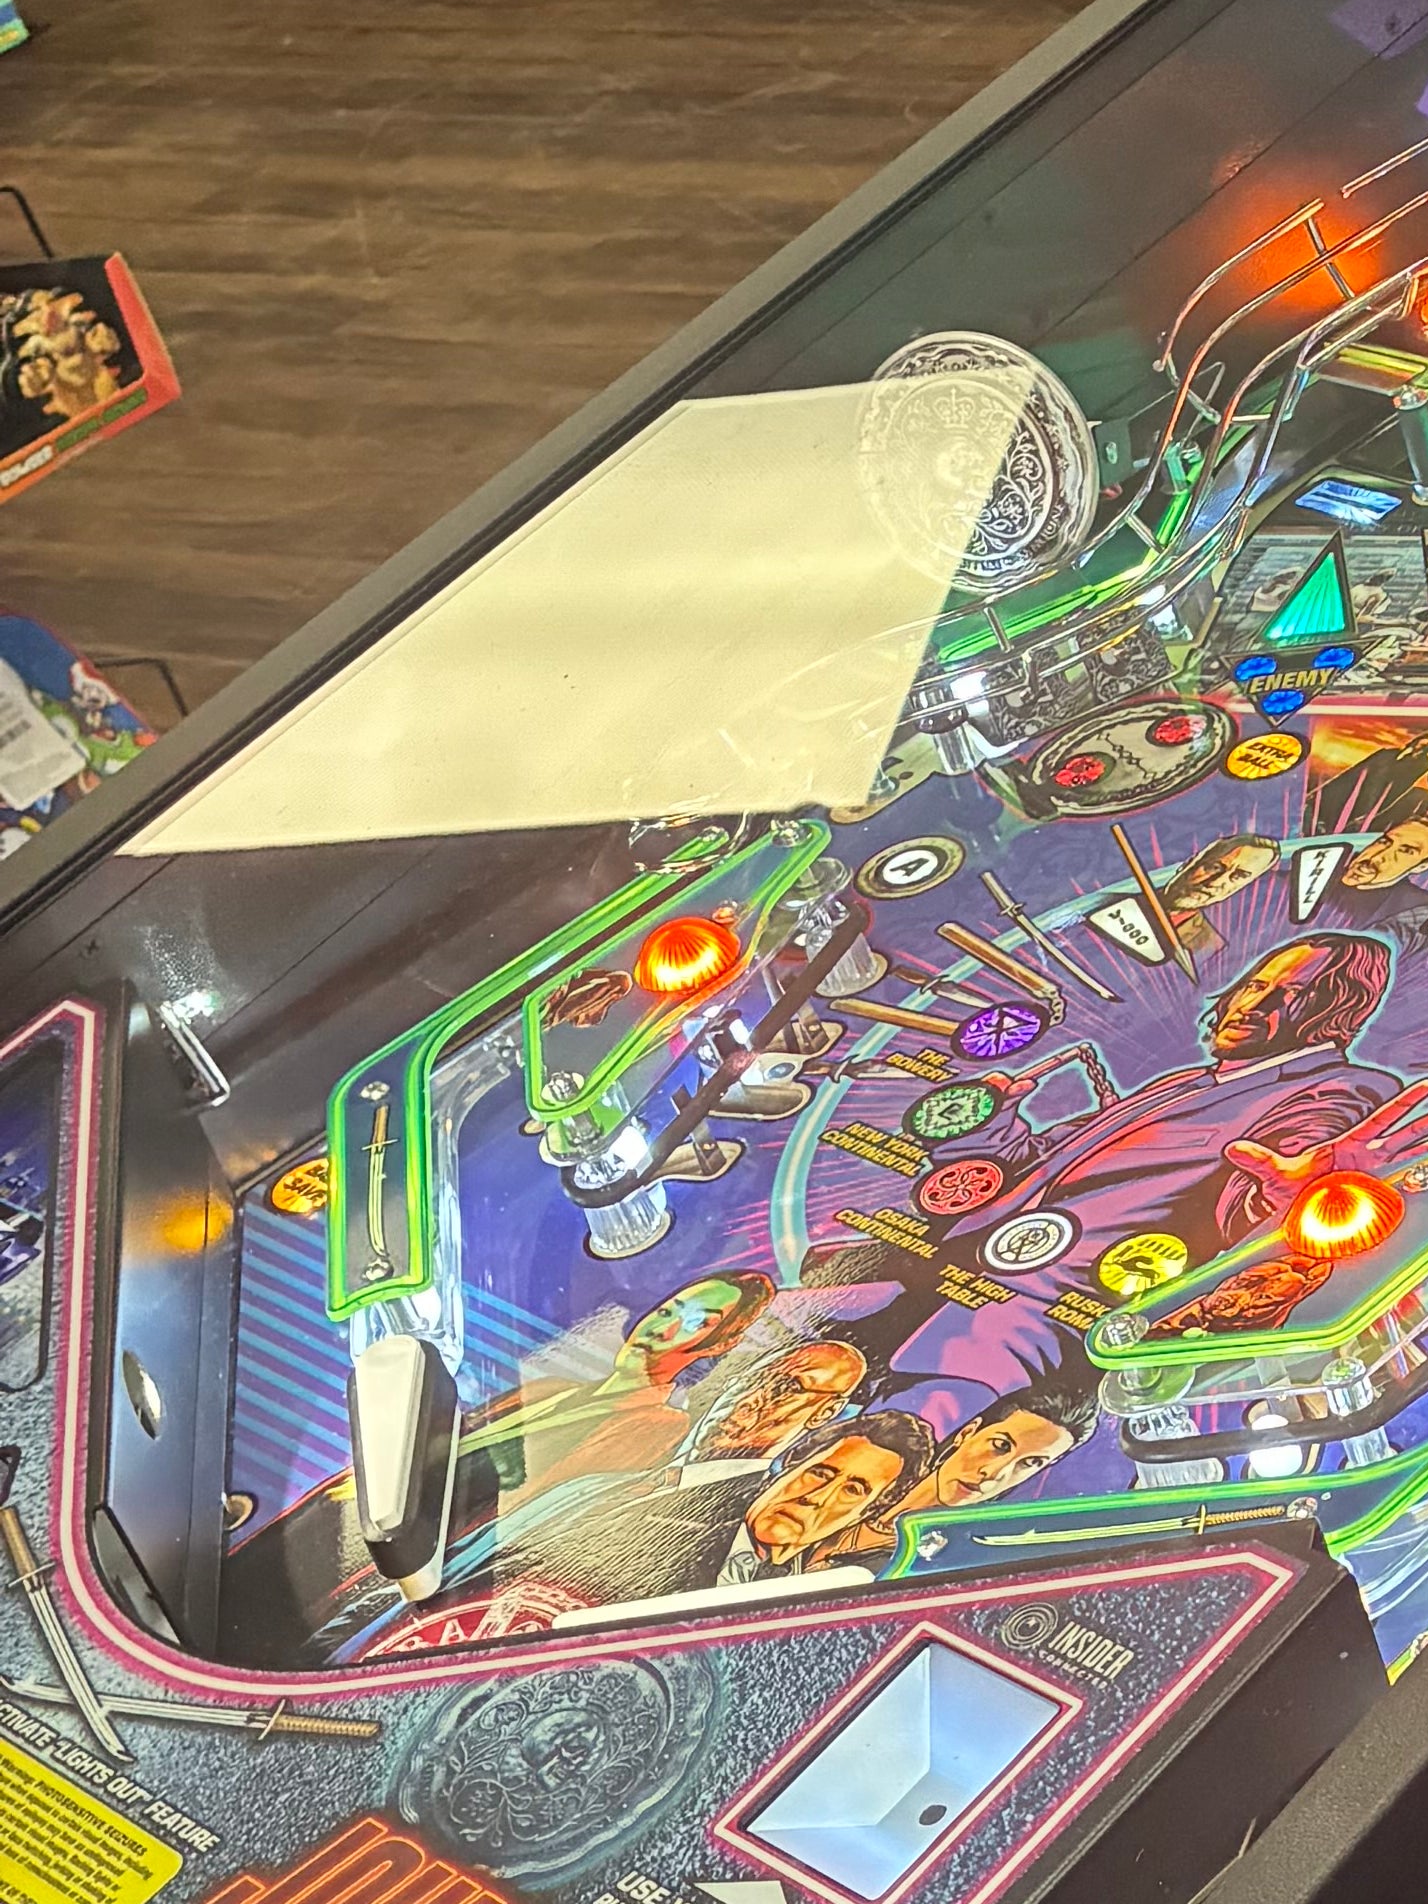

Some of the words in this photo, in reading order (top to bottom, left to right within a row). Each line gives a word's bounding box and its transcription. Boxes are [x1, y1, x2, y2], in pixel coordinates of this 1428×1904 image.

[1250, 667, 1336, 694] ENEMY
[1236, 752, 1274, 771] BALL
[1248, 741, 1292, 761] EXTRA
[889, 857, 930, 877] A
[886, 1052, 953, 1083] BOWERY
[918, 1048, 952, 1067] THE
[822, 1130, 921, 1177] CONTINENTAL
[846, 1122, 886, 1145] NEW
[886, 1137, 929, 1162] YORK
[836, 1209, 938, 1259] CONTINENTAL
[874, 1208, 930, 1236] OSAKA
[936, 1281, 989, 1309] TABLE
[938, 1264, 975, 1285] THE
[970, 1275, 1016, 1302] HIGH
[1061, 1292, 1112, 1318] RUSK
[1048, 1621, 1134, 1680] INSIDER
[0, 1703, 56, 1748] CTIVATE
[143, 1802, 220, 1853] FEATURE
[33, 1777, 107, 1832] PHOTOSENSITIVE
[103, 1823, 148, 1858] SEIZURES
